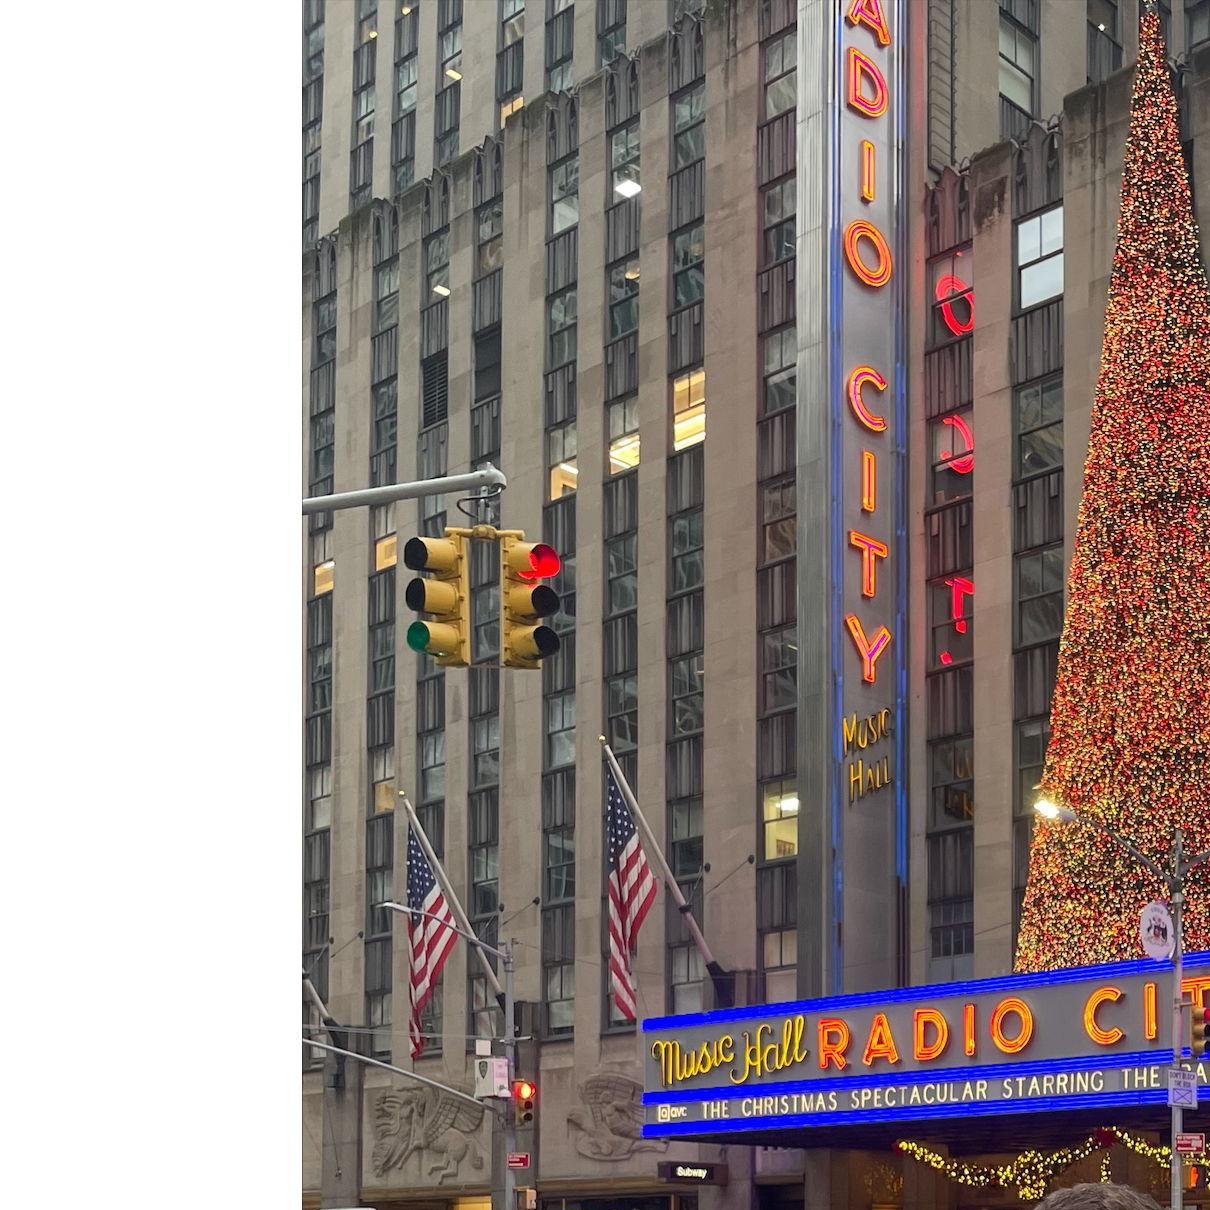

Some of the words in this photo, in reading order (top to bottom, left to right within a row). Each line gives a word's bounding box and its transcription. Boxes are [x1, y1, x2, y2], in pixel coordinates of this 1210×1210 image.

[846, 365, 893, 684] CITY
[841, 707, 894, 757] MUSIC
[848, 757, 894, 805] HALL
[651, 1034, 734, 1087] Music
[730, 1014, 807, 1084] Hall
[817, 996, 1034, 1070] RADIO
[701, 1101, 730, 1120] THE
[741, 1091, 838, 1117] CHRISTMAS
[850, 1079, 988, 1110] SPECTACULAR
[1002, 1071, 1104, 1099] STARRING
[1121, 1066, 1161, 1089] THE
[676, 1166, 707, 1179] Subway
